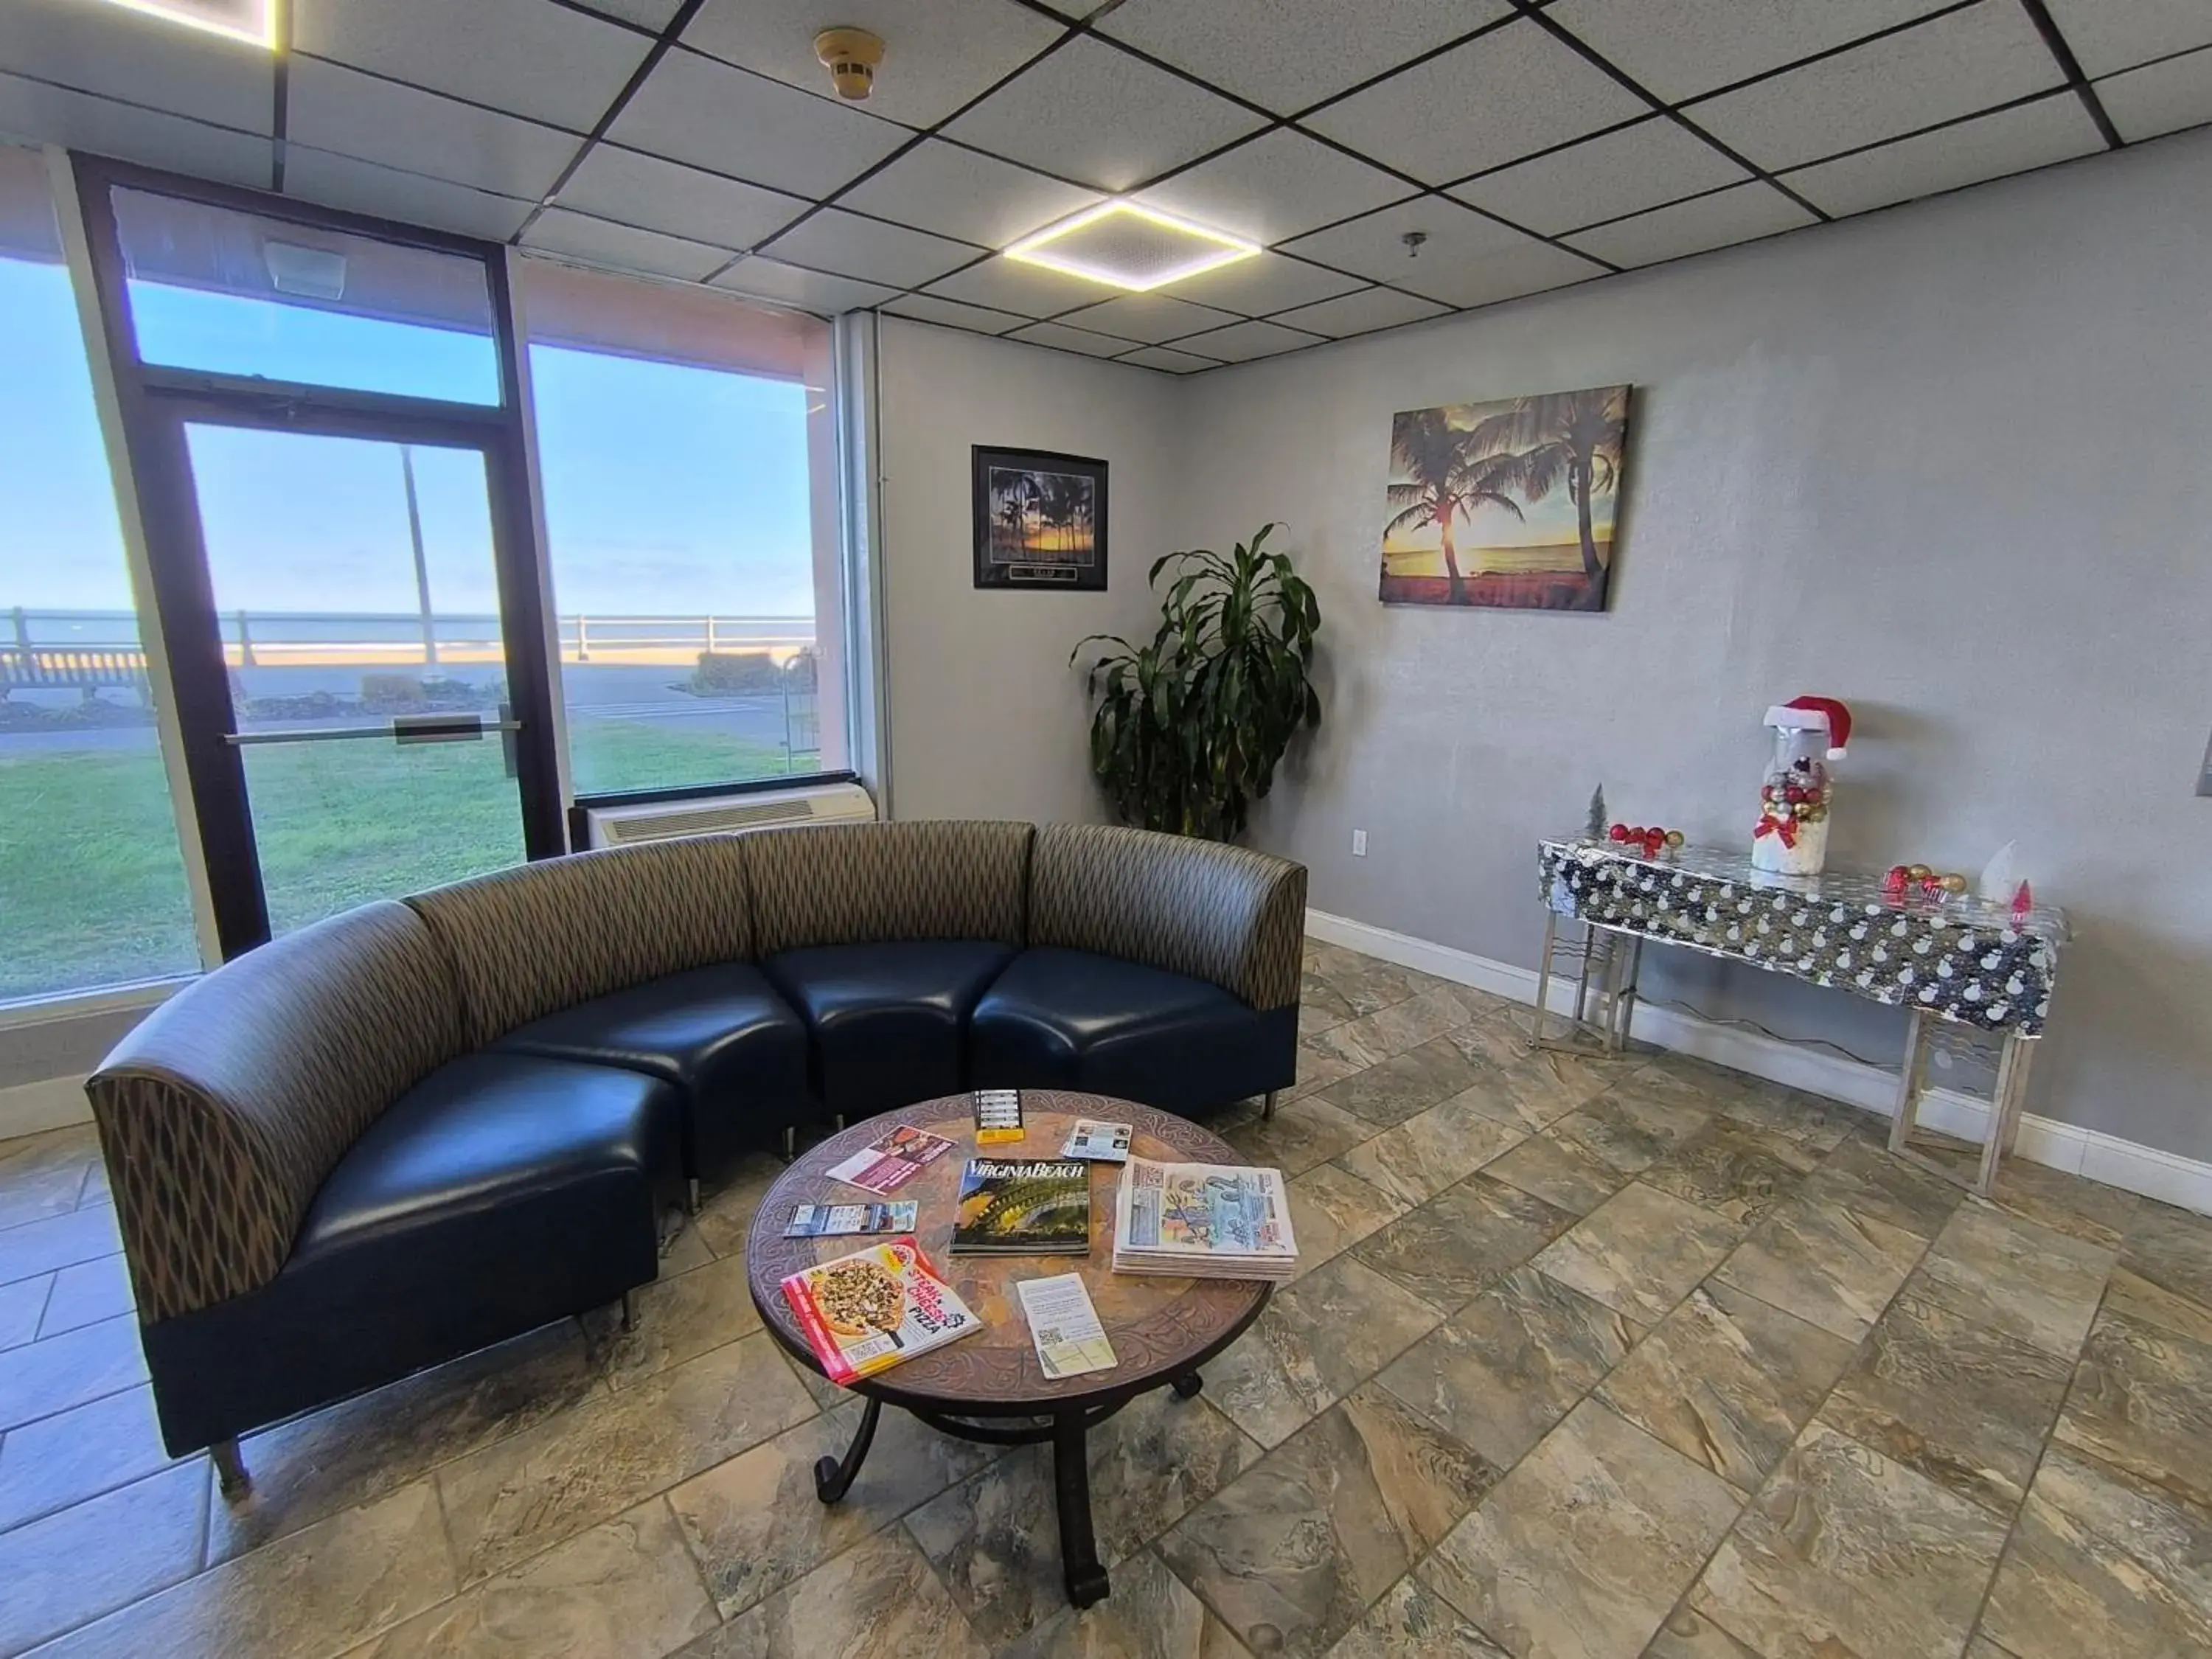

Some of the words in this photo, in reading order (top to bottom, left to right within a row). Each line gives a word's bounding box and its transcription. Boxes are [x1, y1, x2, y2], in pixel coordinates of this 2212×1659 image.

[970, 1160, 1032, 1178] VIRGINIA
[1032, 1162, 1085, 1178] BEACH
[907, 1287, 947, 1323] CHEESE
[908, 1306, 941, 1334] PIZZA
